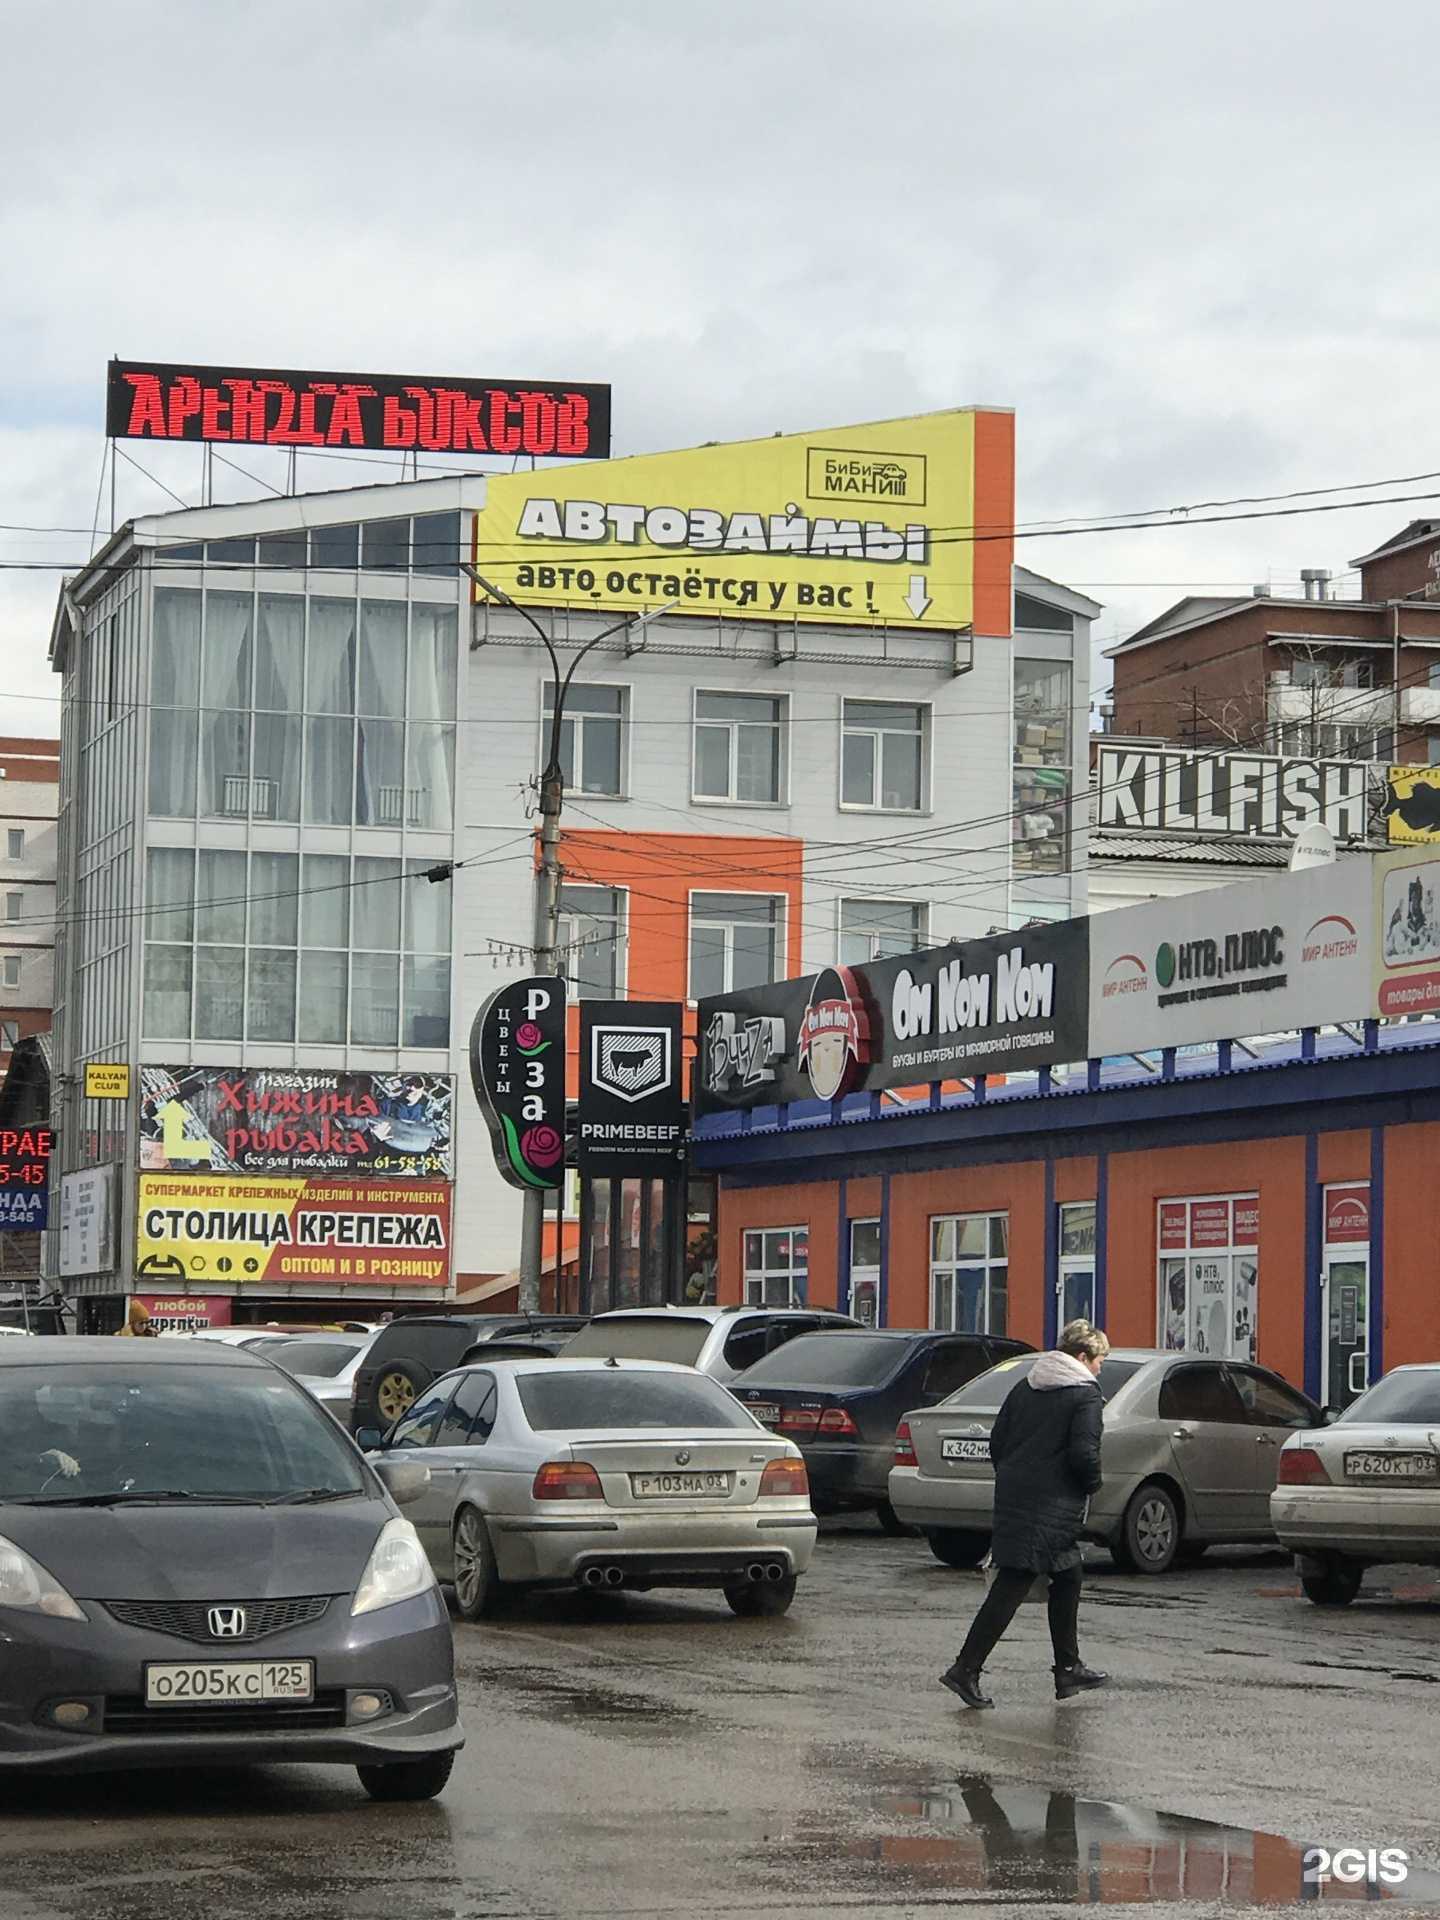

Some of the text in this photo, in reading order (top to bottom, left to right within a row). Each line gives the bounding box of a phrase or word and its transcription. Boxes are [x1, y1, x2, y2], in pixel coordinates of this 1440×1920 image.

[122, 373, 589, 454] АРЕНДА БОКСОВ
[825, 459, 872, 476] БиБи
[516, 498, 927, 564] АВТОЗАЙМЫ
[517, 565, 595, 591] авто
[606, 568, 757, 604] остаётся
[769, 582, 787, 609] у
[797, 583, 853, 608] вас
[1102, 752, 1366, 842] KILLFISH
[1302, 939, 1358, 962] МИР АНТЕНН
[88, 1072, 127, 1081] KALYAN
[94, 1081, 121, 1090] CLUB
[217, 1078, 379, 1116] Хижина
[225, 1116, 369, 1161] рыбака
[581, 1123, 680, 1140] PRIMEBEEF
[0, 1131, 51, 1156] РАЕ
[266, 1156, 288, 1169] для
[292, 1153, 348, 1169] рыбалки
[145, 1183, 445, 1203] СУПЕРМАРКЕТ КРЕПЕЖНЫХ ИЗДЕЛИЙ И ИНСТРУМЕНТА
[146, 1209, 443, 1247] СТОЛИЦА КРЕПЕЖА
[281, 1256, 443, 1279] ОПТОМ И В РОЗНИЦУ
[1352, 1459, 1411, 1474] Р620КТ
[641, 1475, 722, 1492] Р103МА 03
[156, 1666, 303, 1696] О205КС 125
[273, 1687, 293, 1695] RUS
